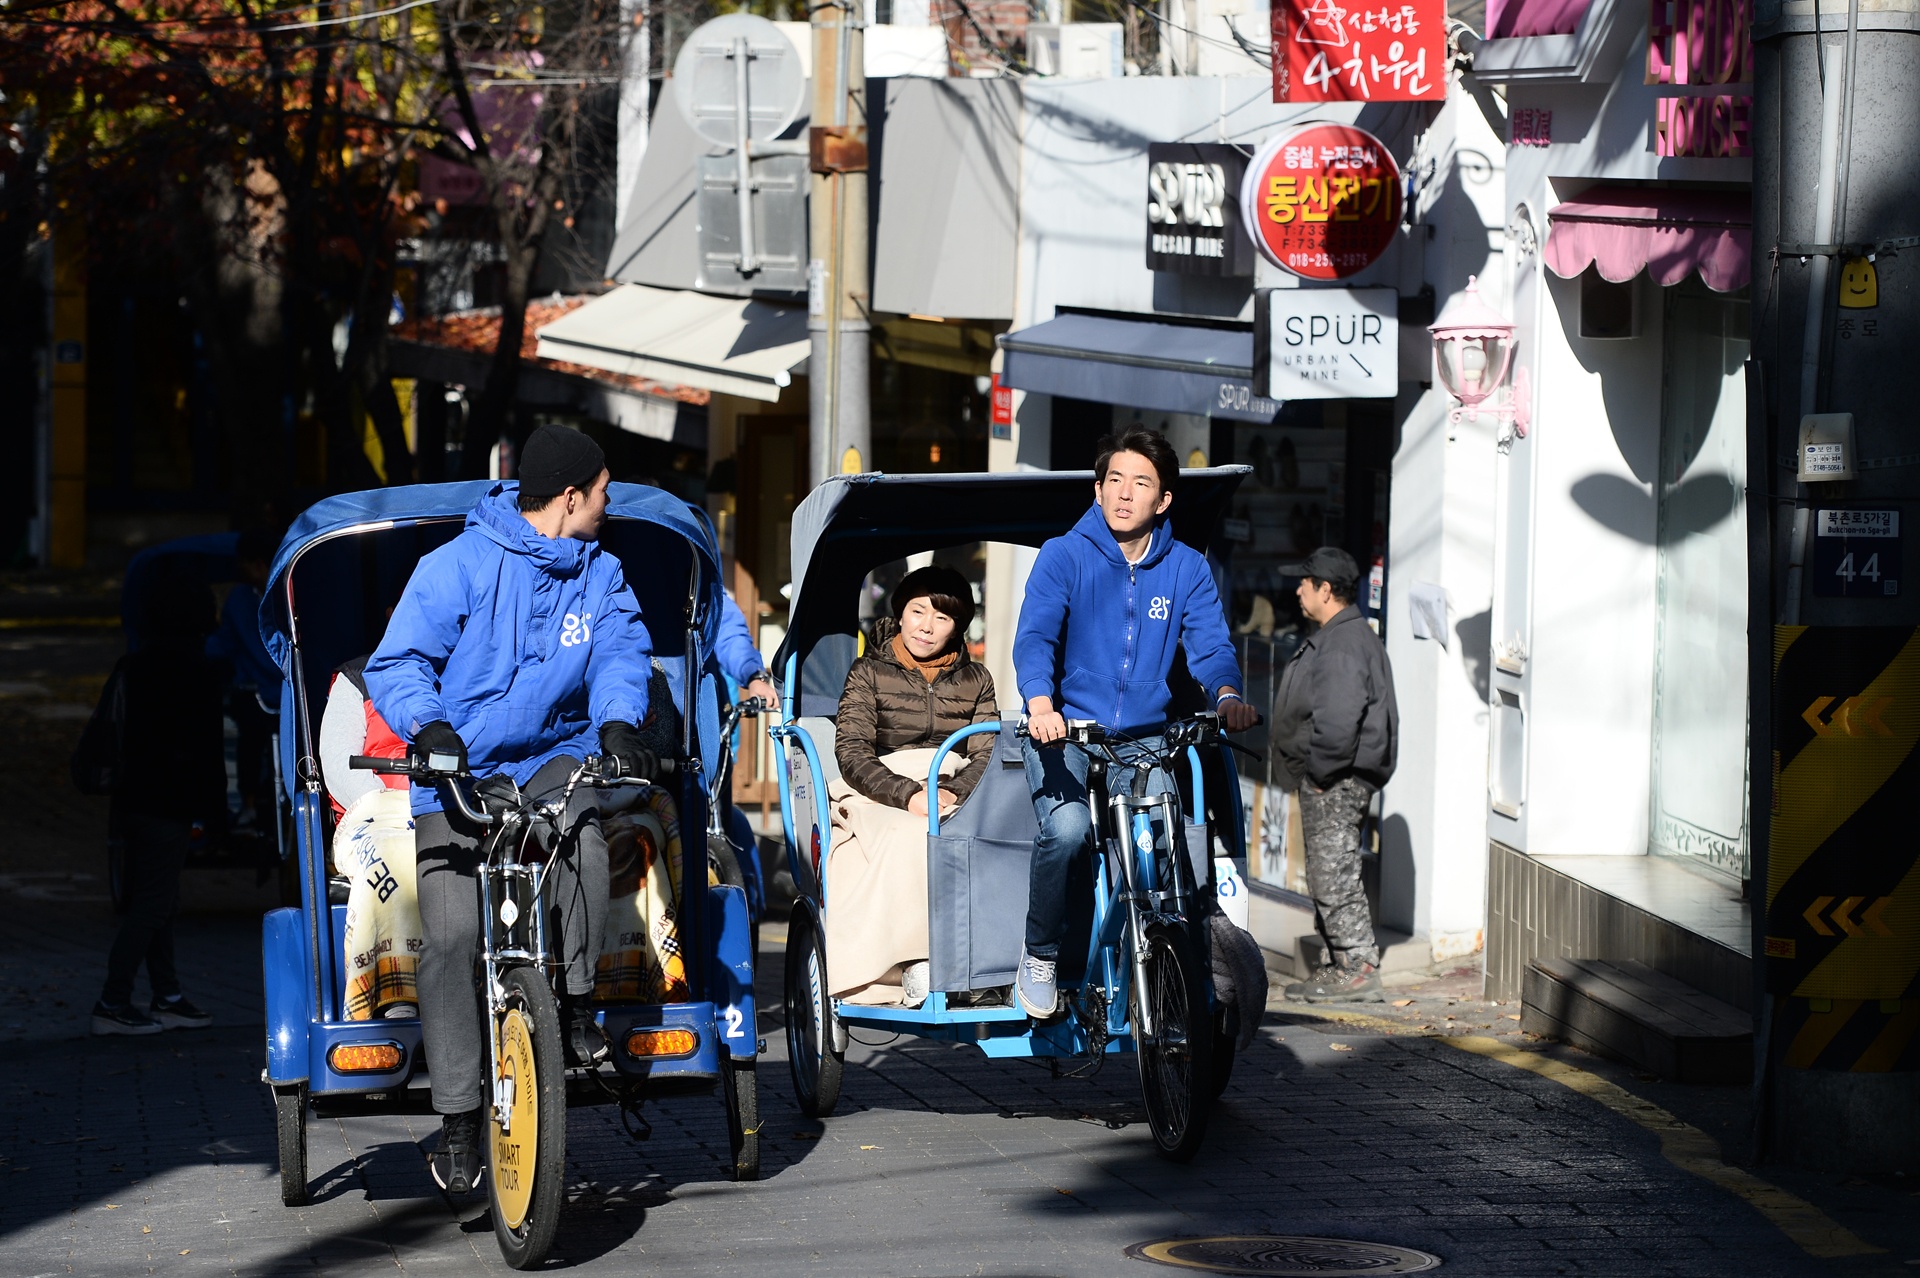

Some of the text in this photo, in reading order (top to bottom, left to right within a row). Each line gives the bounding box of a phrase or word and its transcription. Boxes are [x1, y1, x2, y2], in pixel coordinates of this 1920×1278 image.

[1348, 6, 1421, 36] 삼청동
[1655, 95, 1751, 158] HOUSE
[1265, 175, 1393, 223] 동신전기
[1153, 234, 1191, 255] URBAN
[1284, 355, 1339, 366] URBAN
[1301, 371, 1339, 381] MINE
[1828, 512, 1890, 526] 북촌로5가길
[1828, 526, 1866, 534] Bukchon-ro
[1836, 552, 1881, 582] 44
[725, 1009, 745, 1038] 2
[498, 1144, 521, 1166] SMART
[501, 1168, 520, 1191] TOUR
